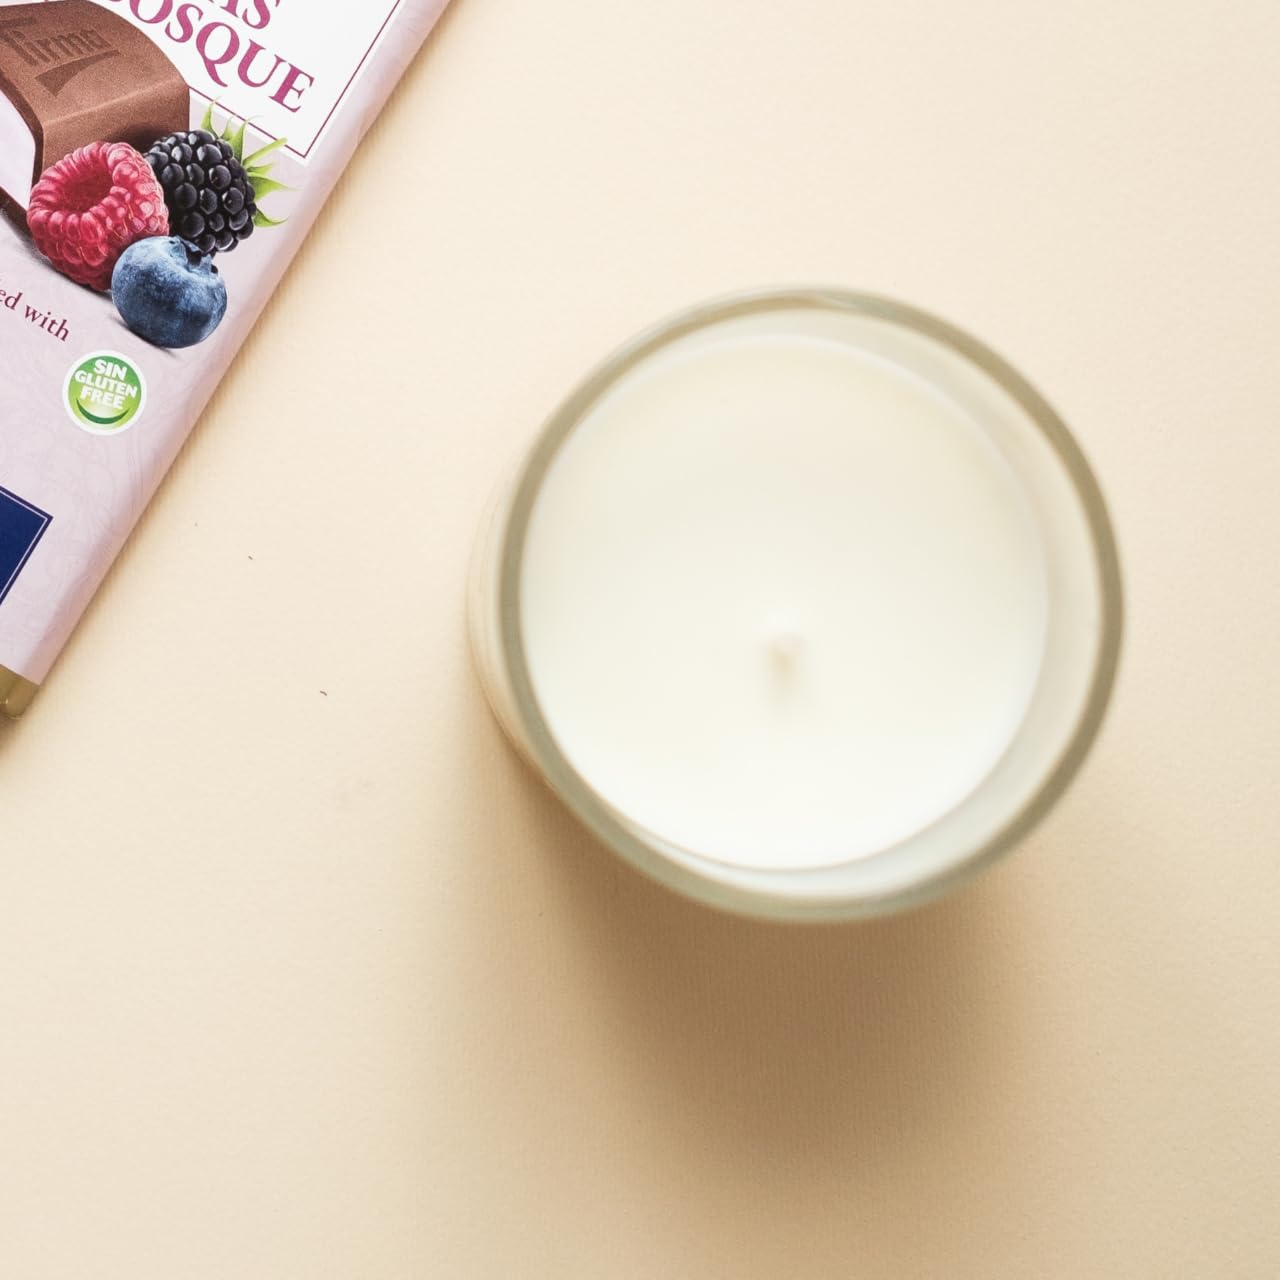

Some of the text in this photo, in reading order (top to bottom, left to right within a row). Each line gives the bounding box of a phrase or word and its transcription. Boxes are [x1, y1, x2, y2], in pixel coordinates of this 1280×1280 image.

[23, 302, 71, 342] with
[94, 358, 128, 381] SIN
[74, 368, 138, 398] GLUTEN
[80, 387, 125, 410] FREE
